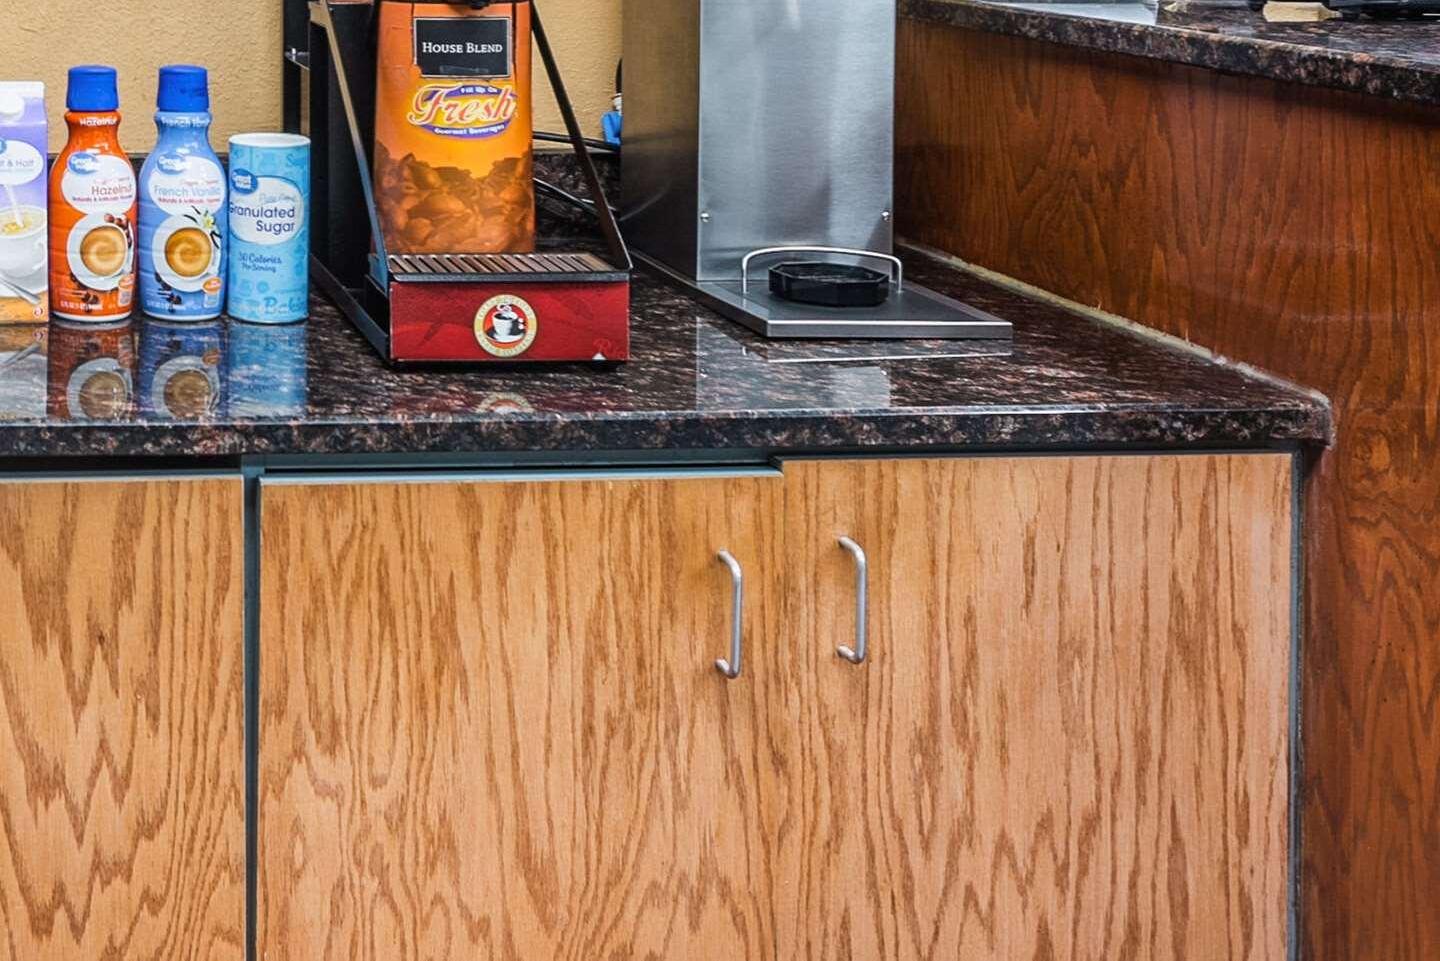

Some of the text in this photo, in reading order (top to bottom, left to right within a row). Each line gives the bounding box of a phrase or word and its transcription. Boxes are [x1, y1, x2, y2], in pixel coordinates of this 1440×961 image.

[422, 41, 503, 53] HOUSE BLEND
[406, 82, 518, 126] Fresh
[256, 219, 296, 236] Sugar
